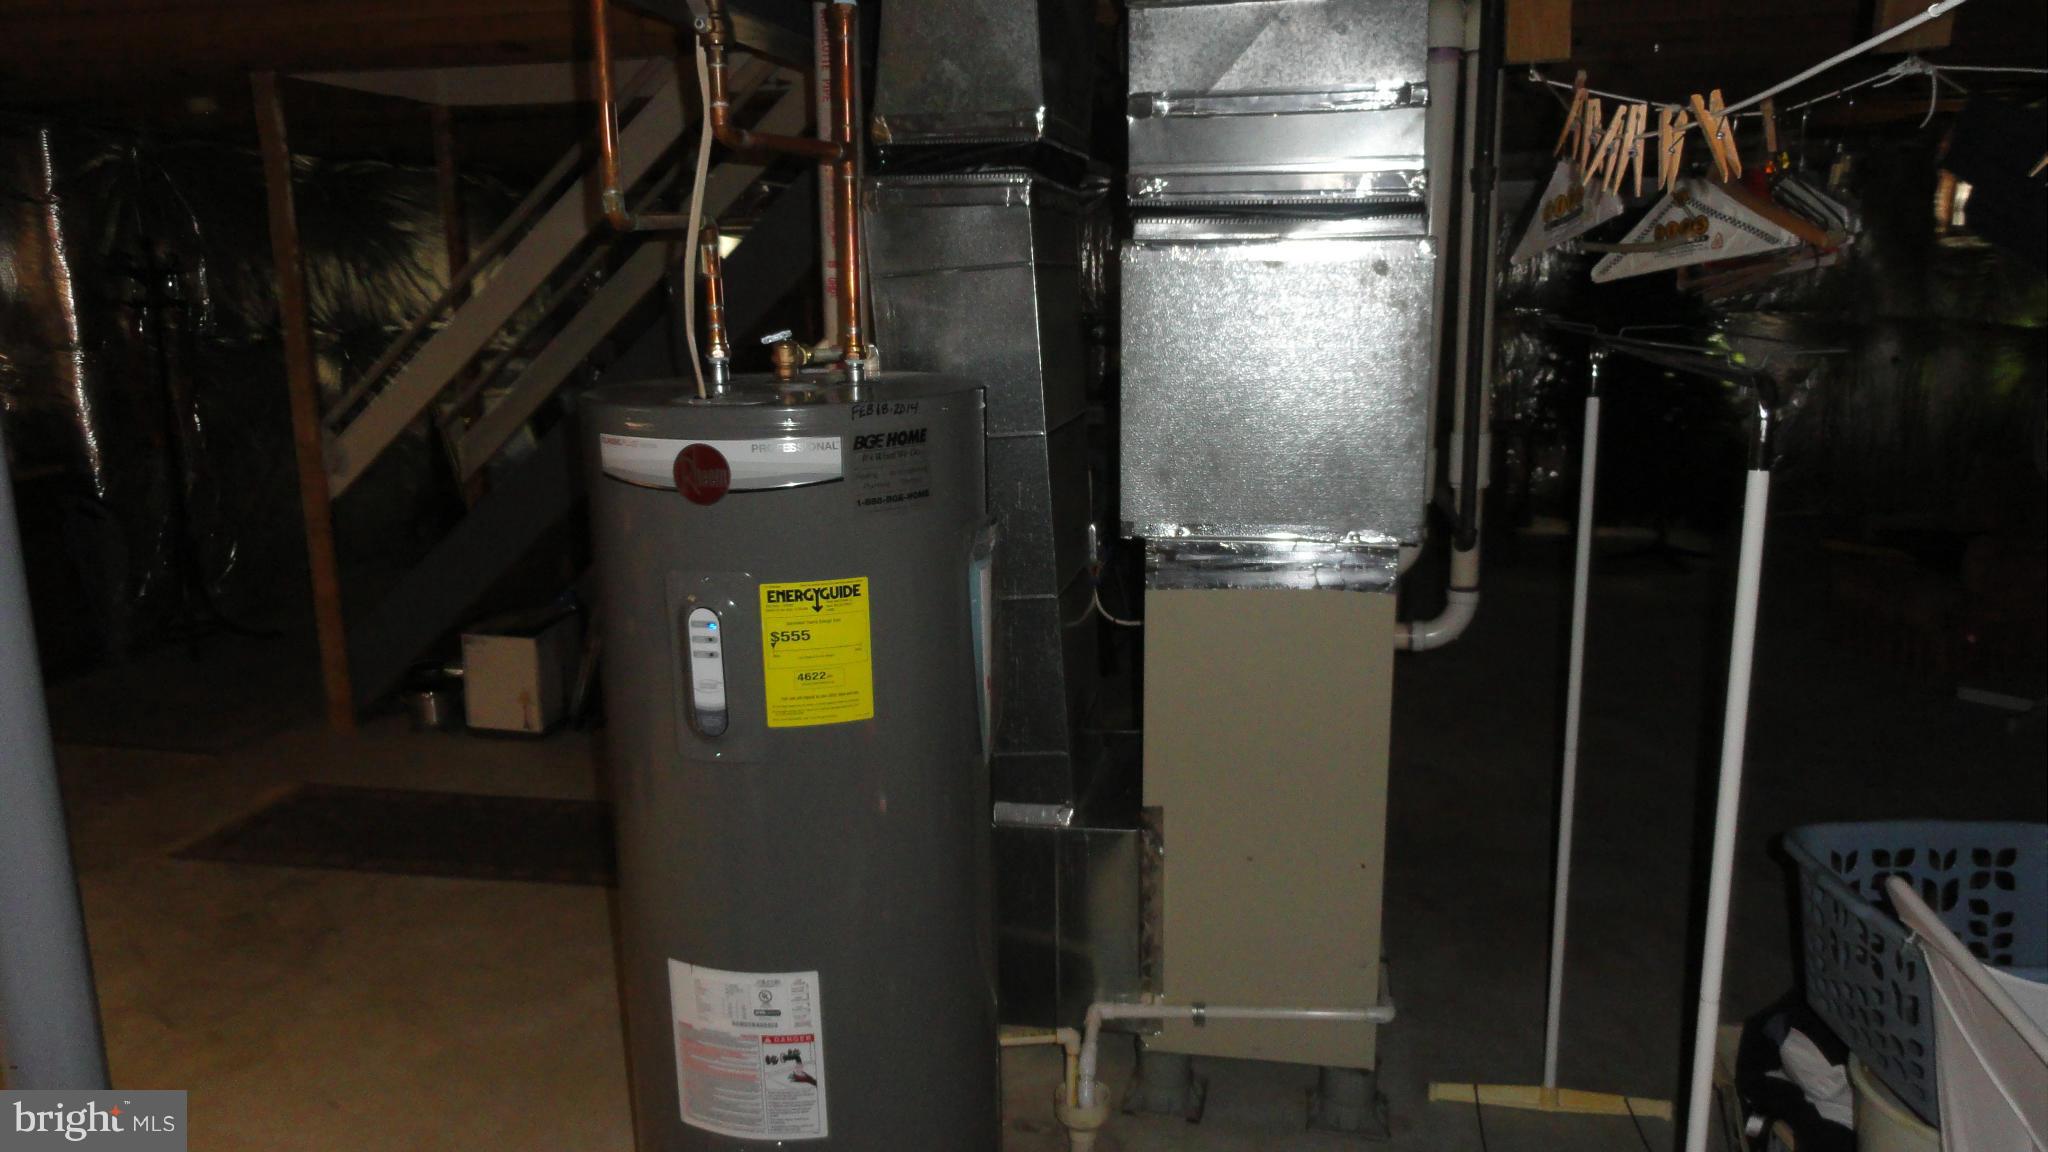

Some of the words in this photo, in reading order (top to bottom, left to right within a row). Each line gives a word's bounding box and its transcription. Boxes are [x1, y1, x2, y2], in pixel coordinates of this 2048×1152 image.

[853, 433, 885, 450] BGE
[886, 427, 927, 447] HOME
[770, 629, 811, 643] $555
[797, 671, 826, 681] 4622
[774, 1034, 812, 1043] DANGER
